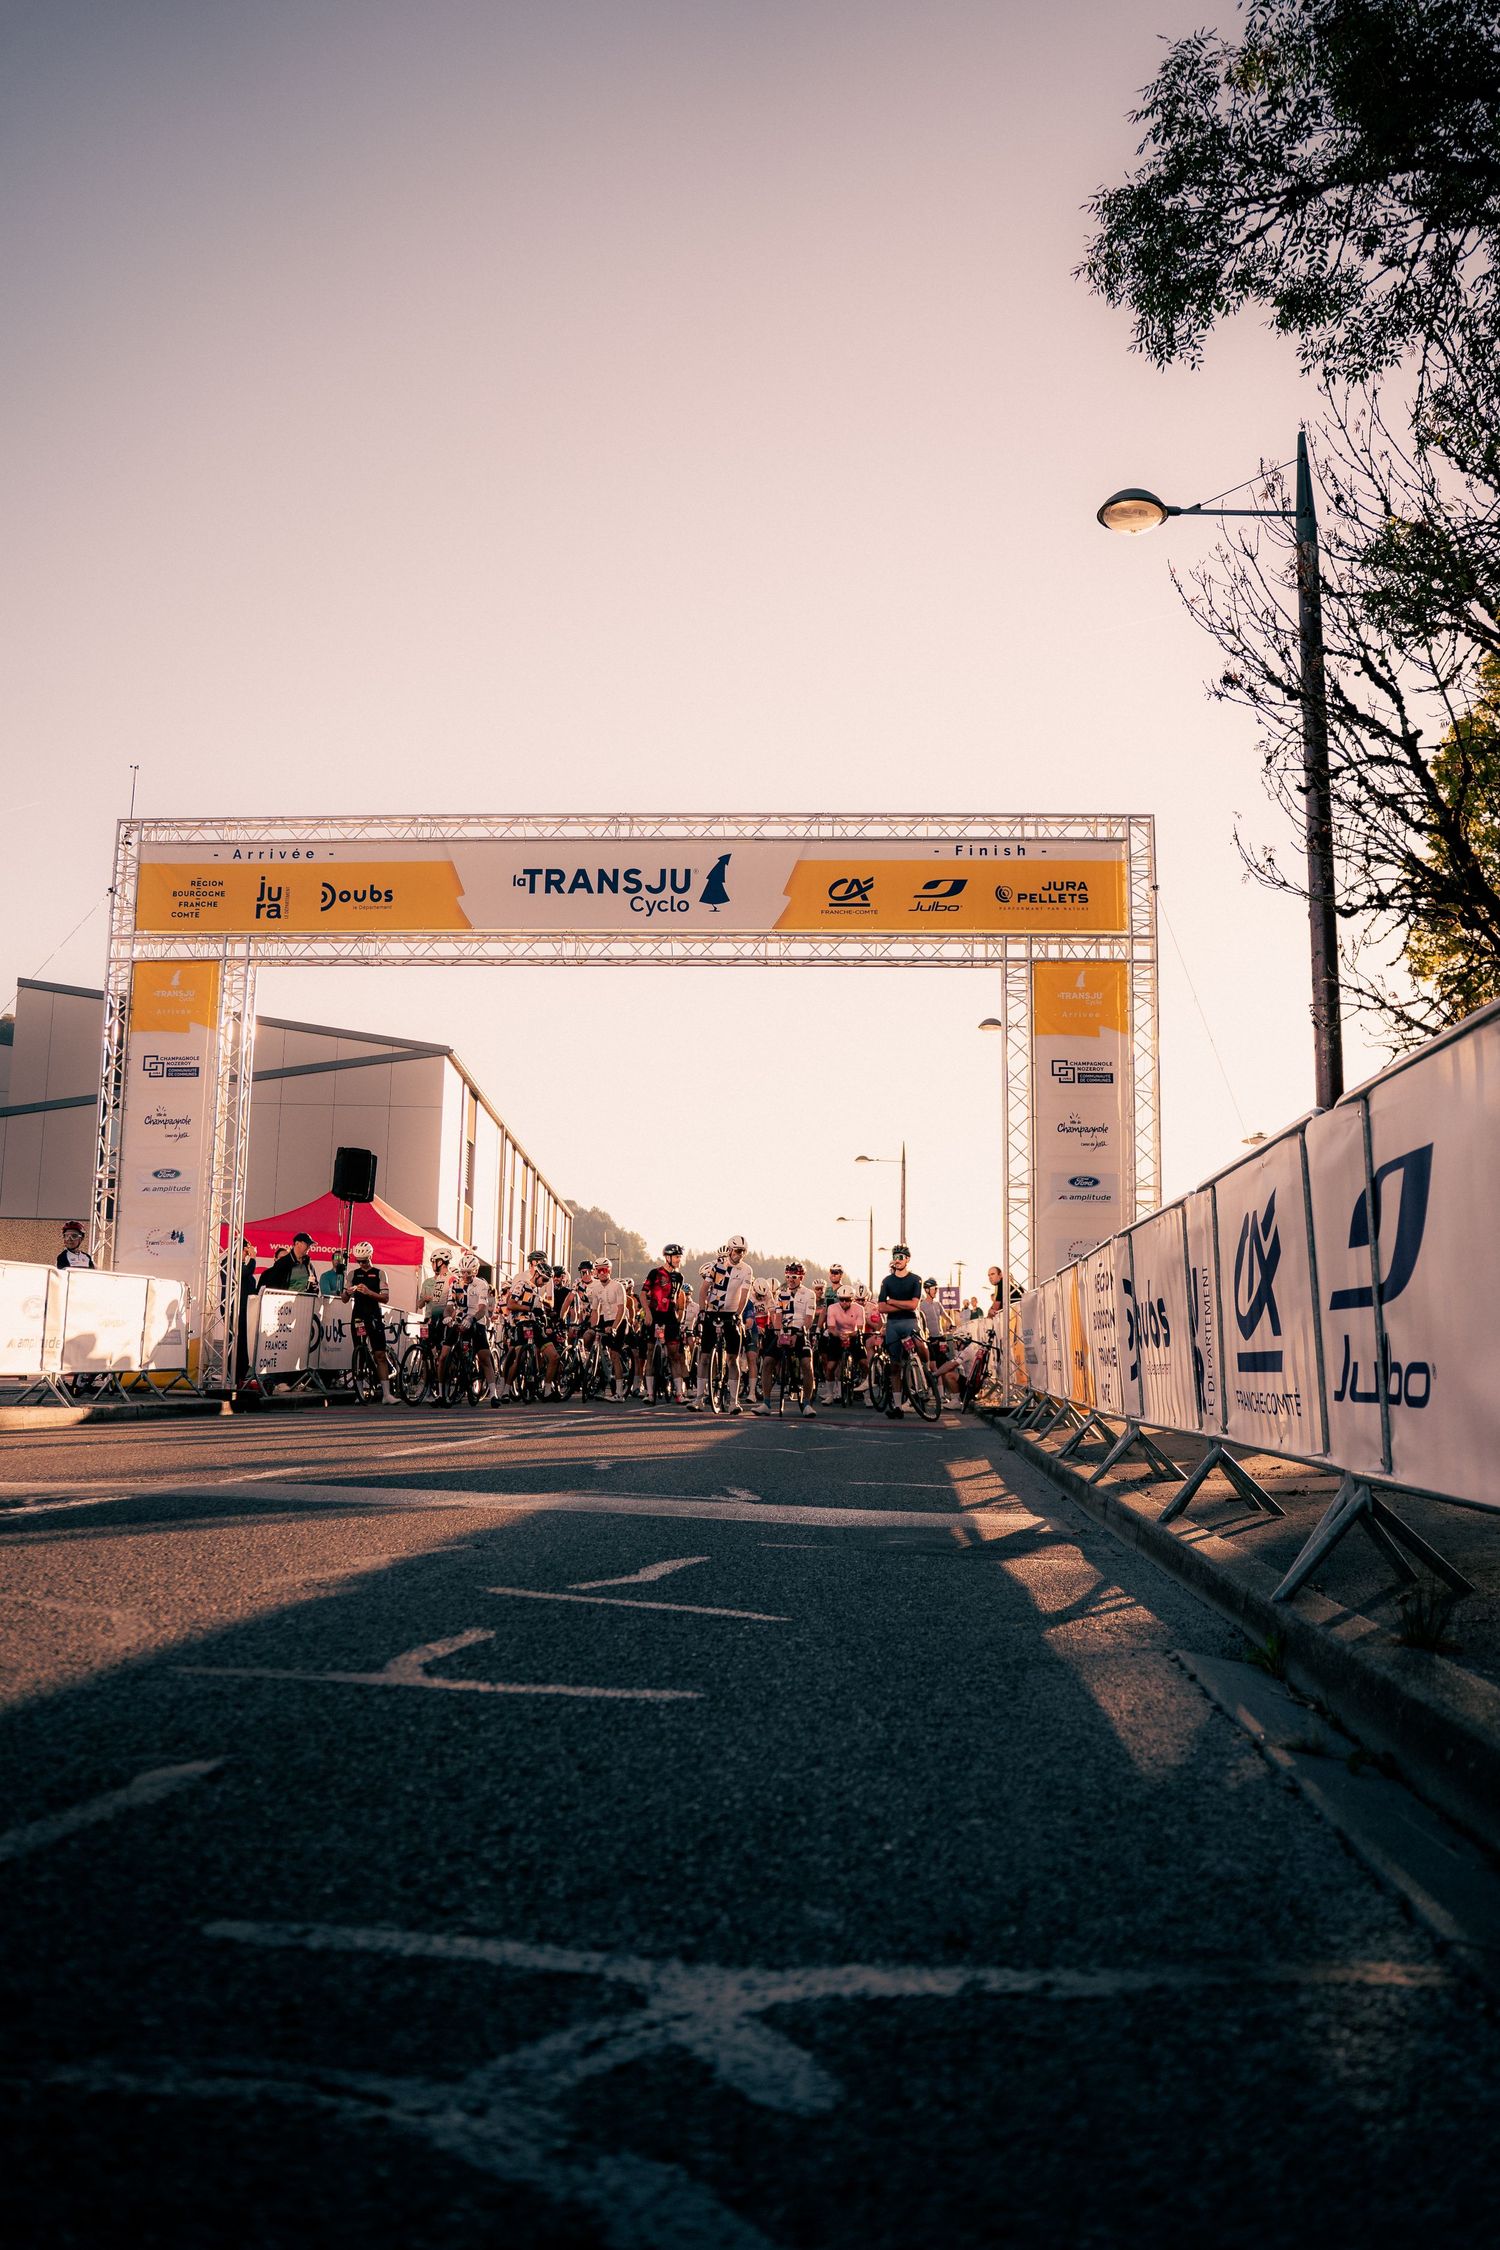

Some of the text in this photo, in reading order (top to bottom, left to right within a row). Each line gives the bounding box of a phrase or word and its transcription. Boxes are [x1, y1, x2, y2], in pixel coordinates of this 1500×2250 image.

[232, 848, 315, 860] Arrivée
[955, 844, 1026, 856] Finish
[1041, 881, 1089, 892] JURA
[172, 890, 226, 898] BOURGOGNE
[320, 882, 394, 912] Doubs
[1017, 893, 1089, 904] PELLETS
[629, 895, 690, 917] Cyclo
[144, 1114, 192, 1130] Champagnole
[1057, 1121, 1109, 1139] Champagnole
[151, 1185, 191, 1193] amplitude
[1069, 1193, 1112, 1201] amplitude
[1235, 1387, 1302, 1417] FRANCHE-COMTÉ
